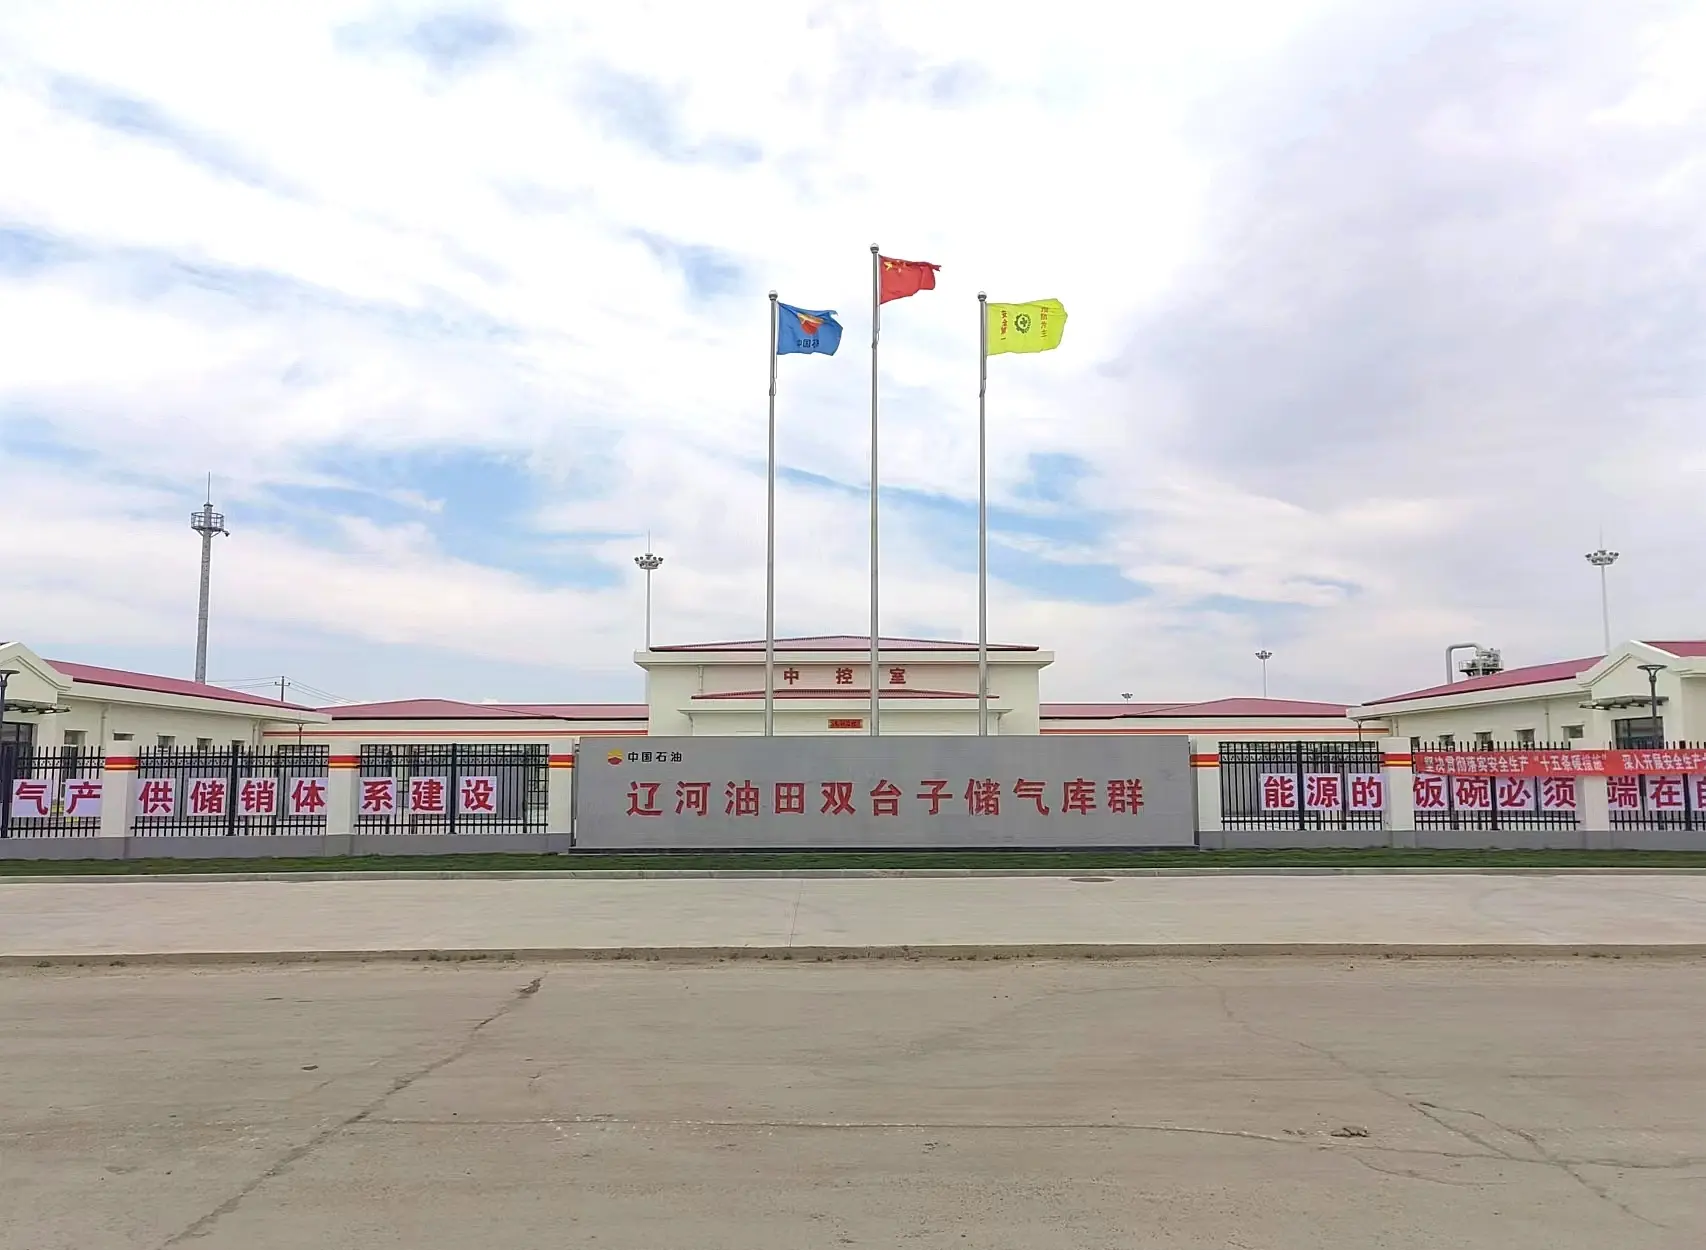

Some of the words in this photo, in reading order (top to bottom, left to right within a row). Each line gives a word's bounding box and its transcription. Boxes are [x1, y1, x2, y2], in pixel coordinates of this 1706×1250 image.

[783, 667, 907, 685] 中控室
[627, 751, 682, 763] 中国石油
[1621, 752, 1706, 771] 深入开展安全生产
[626, 778, 1145, 816] 辽河油田双台子储气库群
